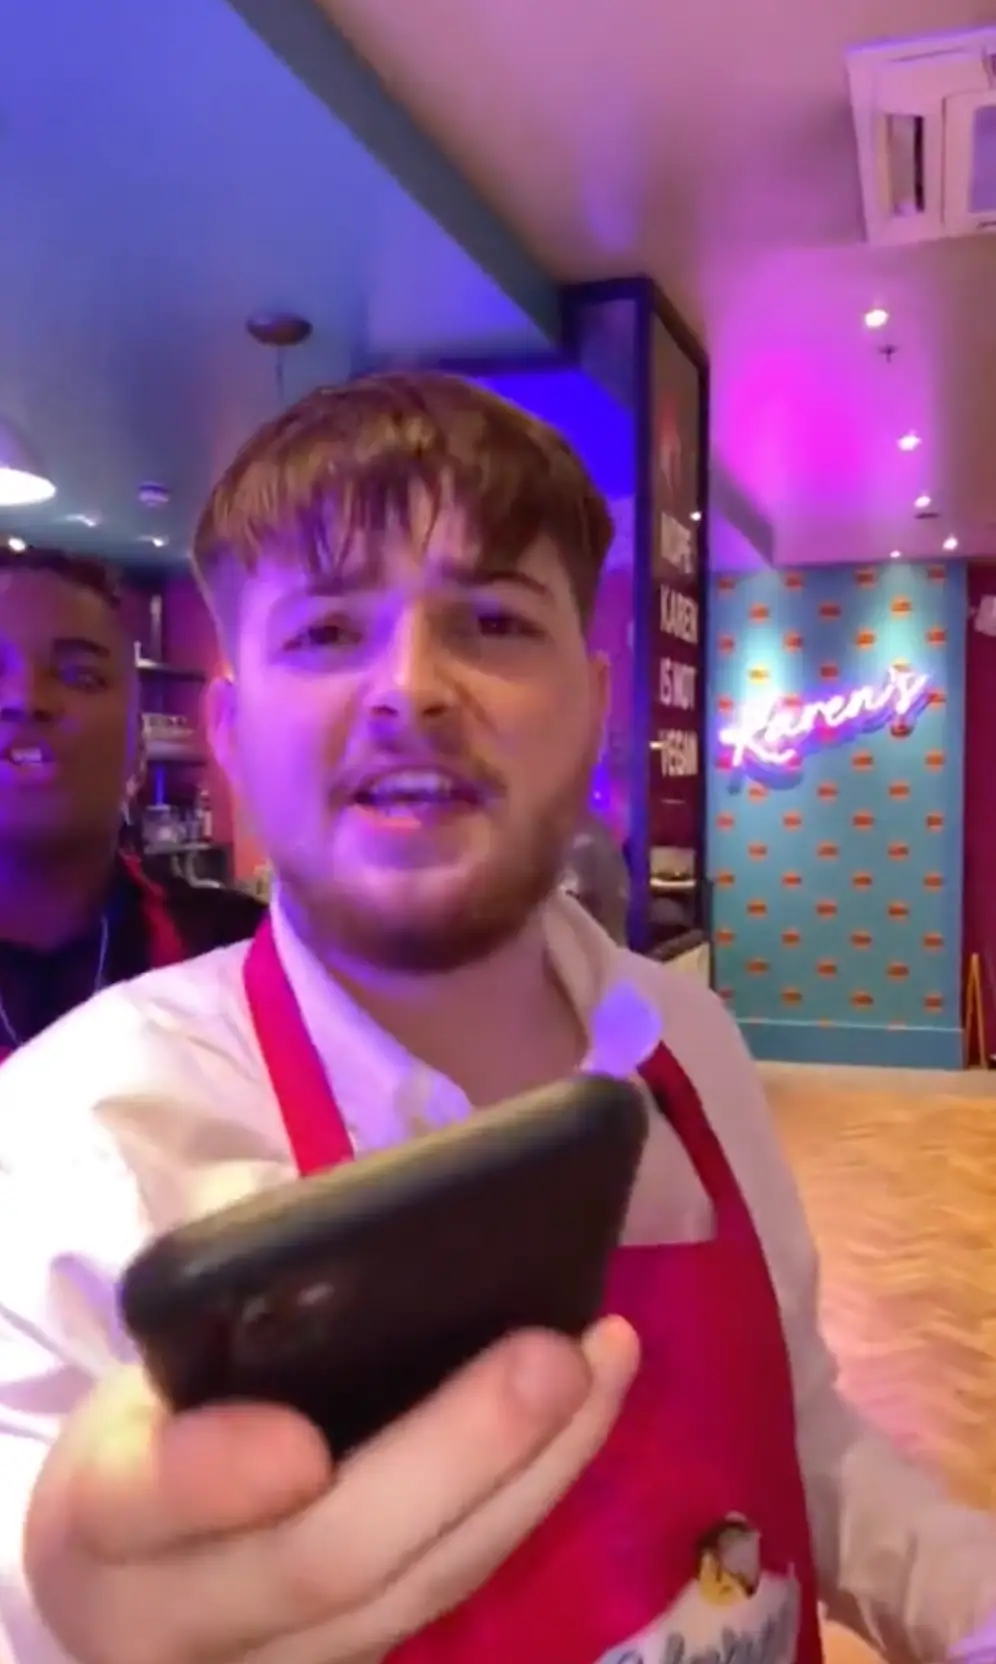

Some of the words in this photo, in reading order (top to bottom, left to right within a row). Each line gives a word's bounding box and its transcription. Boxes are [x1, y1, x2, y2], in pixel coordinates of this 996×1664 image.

[660, 584, 699, 645] KAREN
[660, 656, 672, 706] IS
[672, 660, 696, 711] NOT
[718, 665, 931, 768] Karen's
[658, 728, 699, 777] VEGAN
